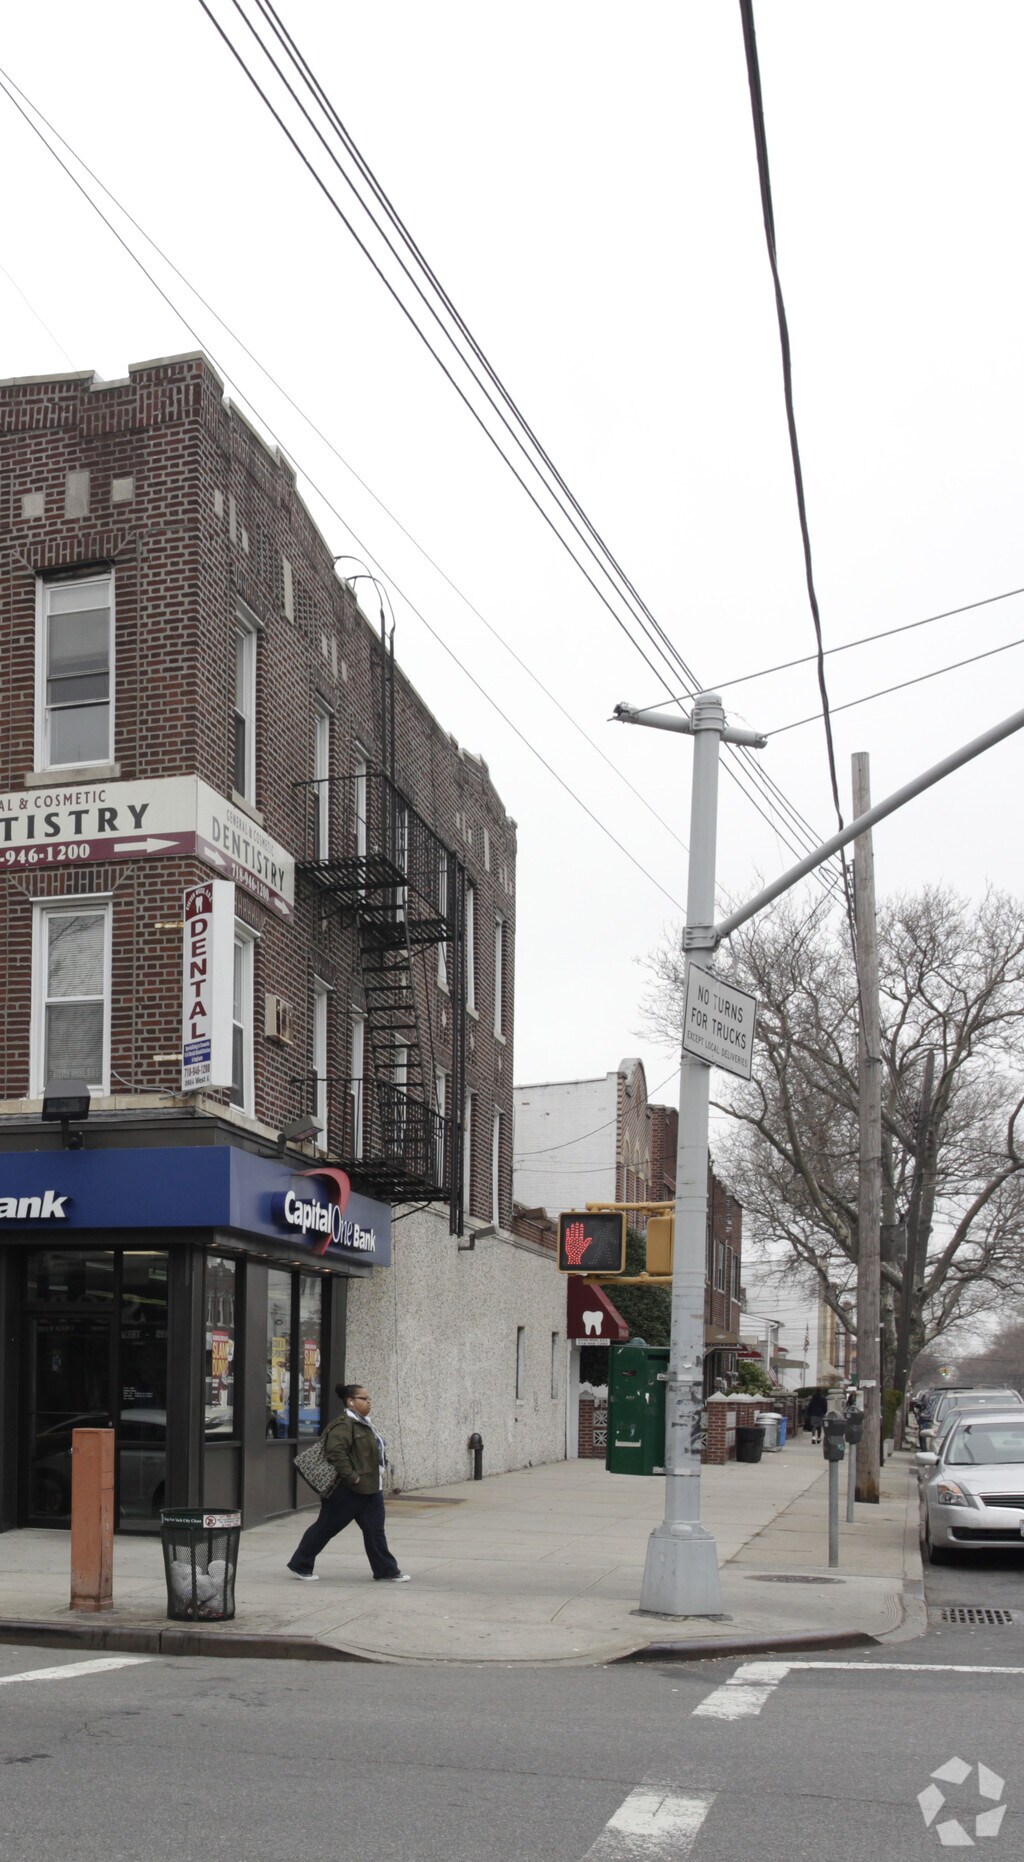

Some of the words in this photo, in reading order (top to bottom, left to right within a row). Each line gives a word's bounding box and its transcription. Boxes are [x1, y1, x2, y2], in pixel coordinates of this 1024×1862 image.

[19, 797, 28, 810] &
[34, 790, 106, 808] COSMETIC
[212, 815, 285, 892] DENTISTRY
[189, 918, 208, 1040] DENTAL
[698, 985, 710, 1005] NO
[713, 994, 743, 1023] TURNS
[691, 1007, 708, 1030] FOR
[712, 1019, 747, 1050] TRUCKS
[687, 1030, 704, 1046] EXCEPT
[705, 1040, 720, 1054] LOCAL
[721, 1048, 748, 1068] DELIVERIES
[353, 1223, 376, 1252] Bank
